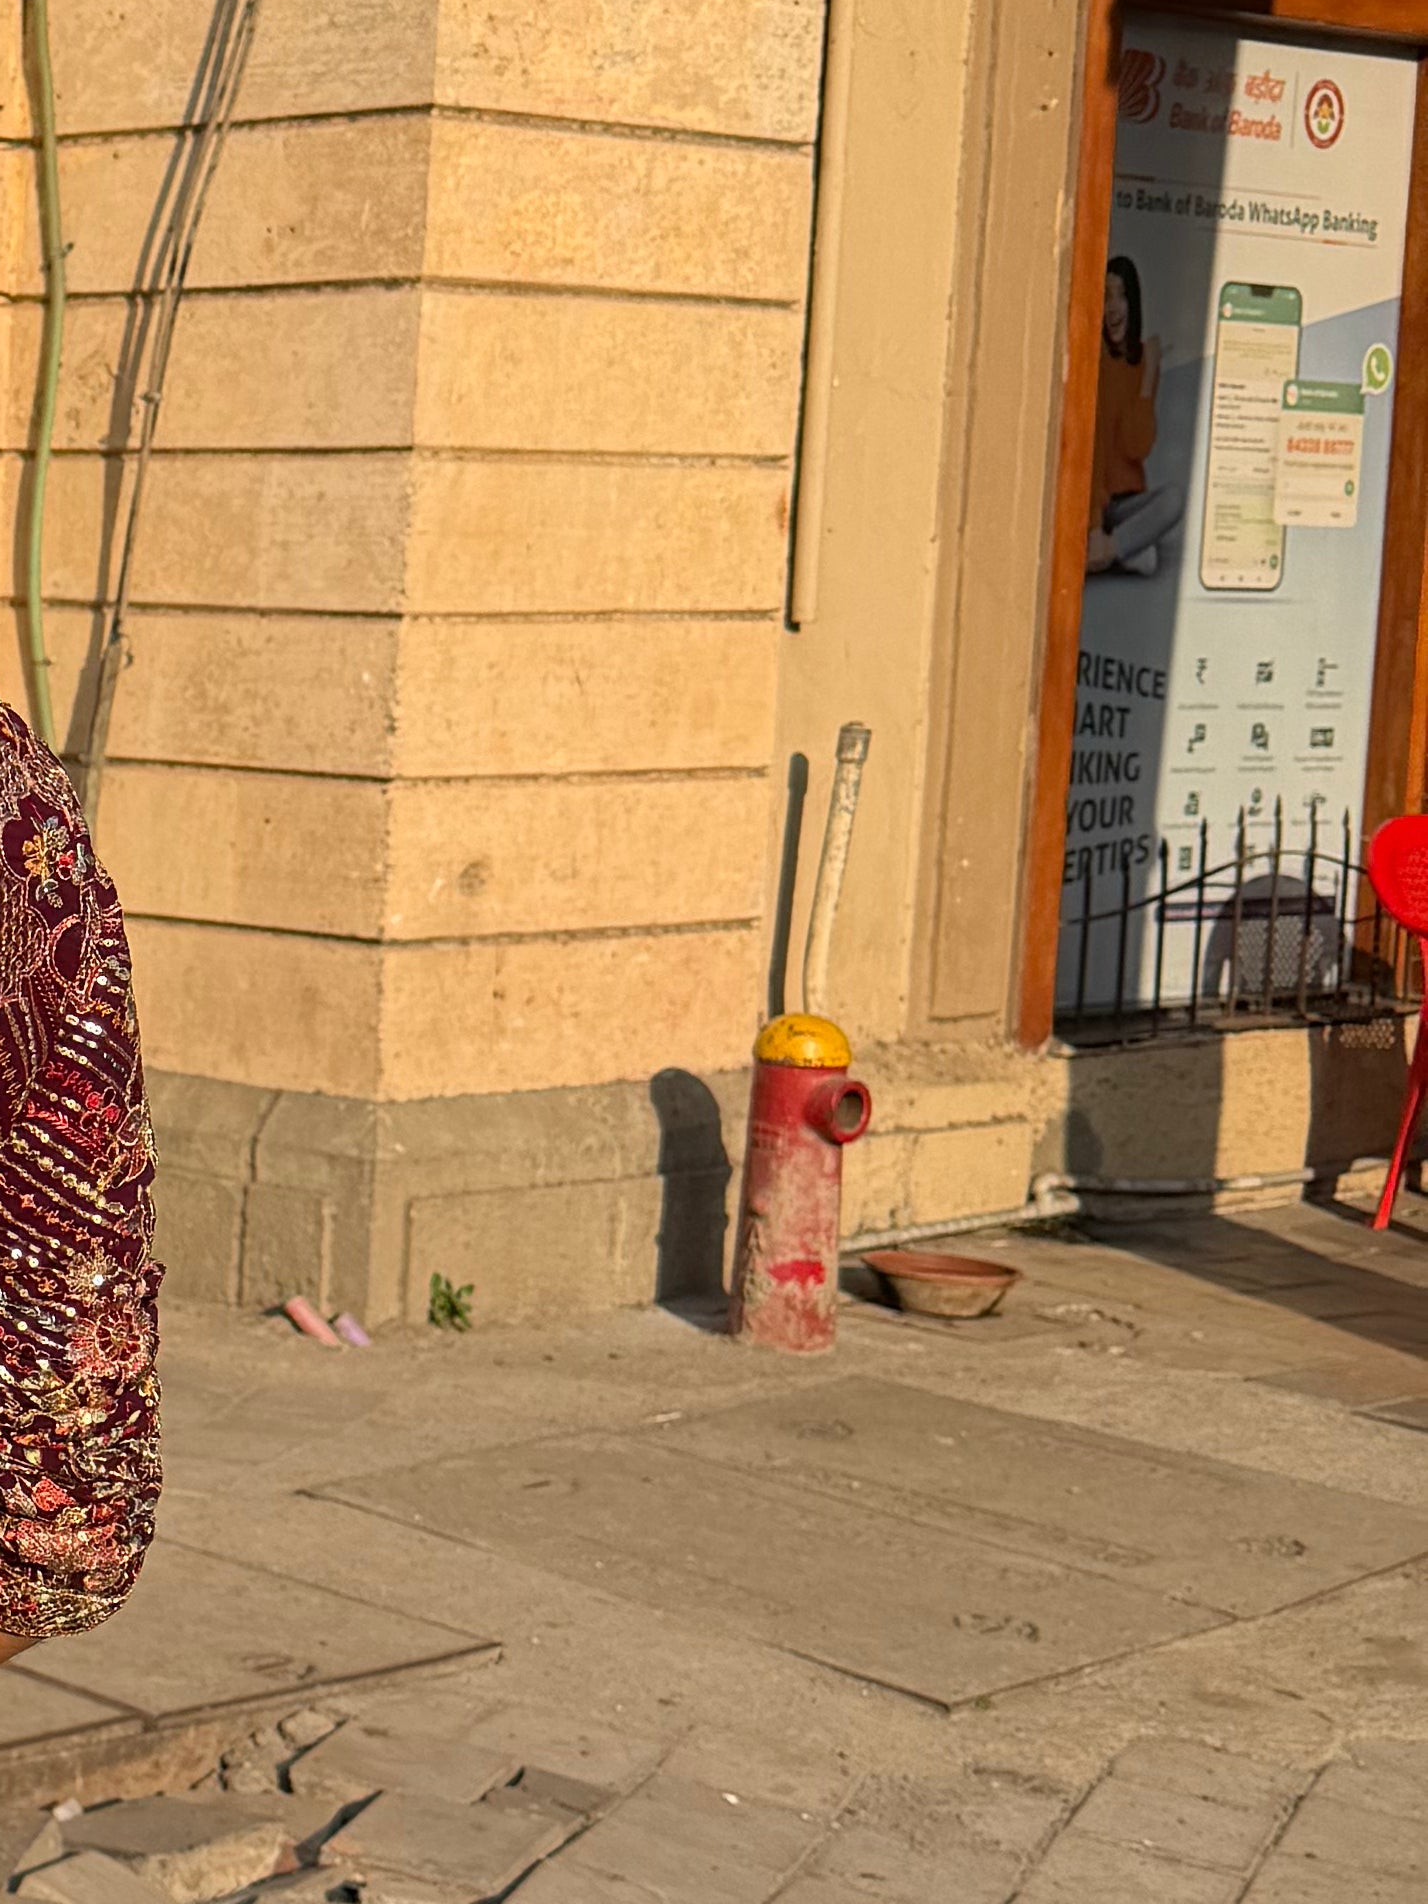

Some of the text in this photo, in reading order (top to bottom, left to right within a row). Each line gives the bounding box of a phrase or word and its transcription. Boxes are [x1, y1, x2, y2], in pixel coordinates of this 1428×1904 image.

[1170, 102, 1208, 132] Bank
[1227, 110, 1282, 140] Baroda
[1136, 189, 1172, 212] Bank
[1174, 193, 1192, 215] of
[1194, 195, 1245, 221] Baroda
[1248, 201, 1320, 236] WhatsApp
[1322, 209, 1379, 241] Banking
[1073, 701, 1131, 738] ART
[1070, 750, 1141, 785] KING
